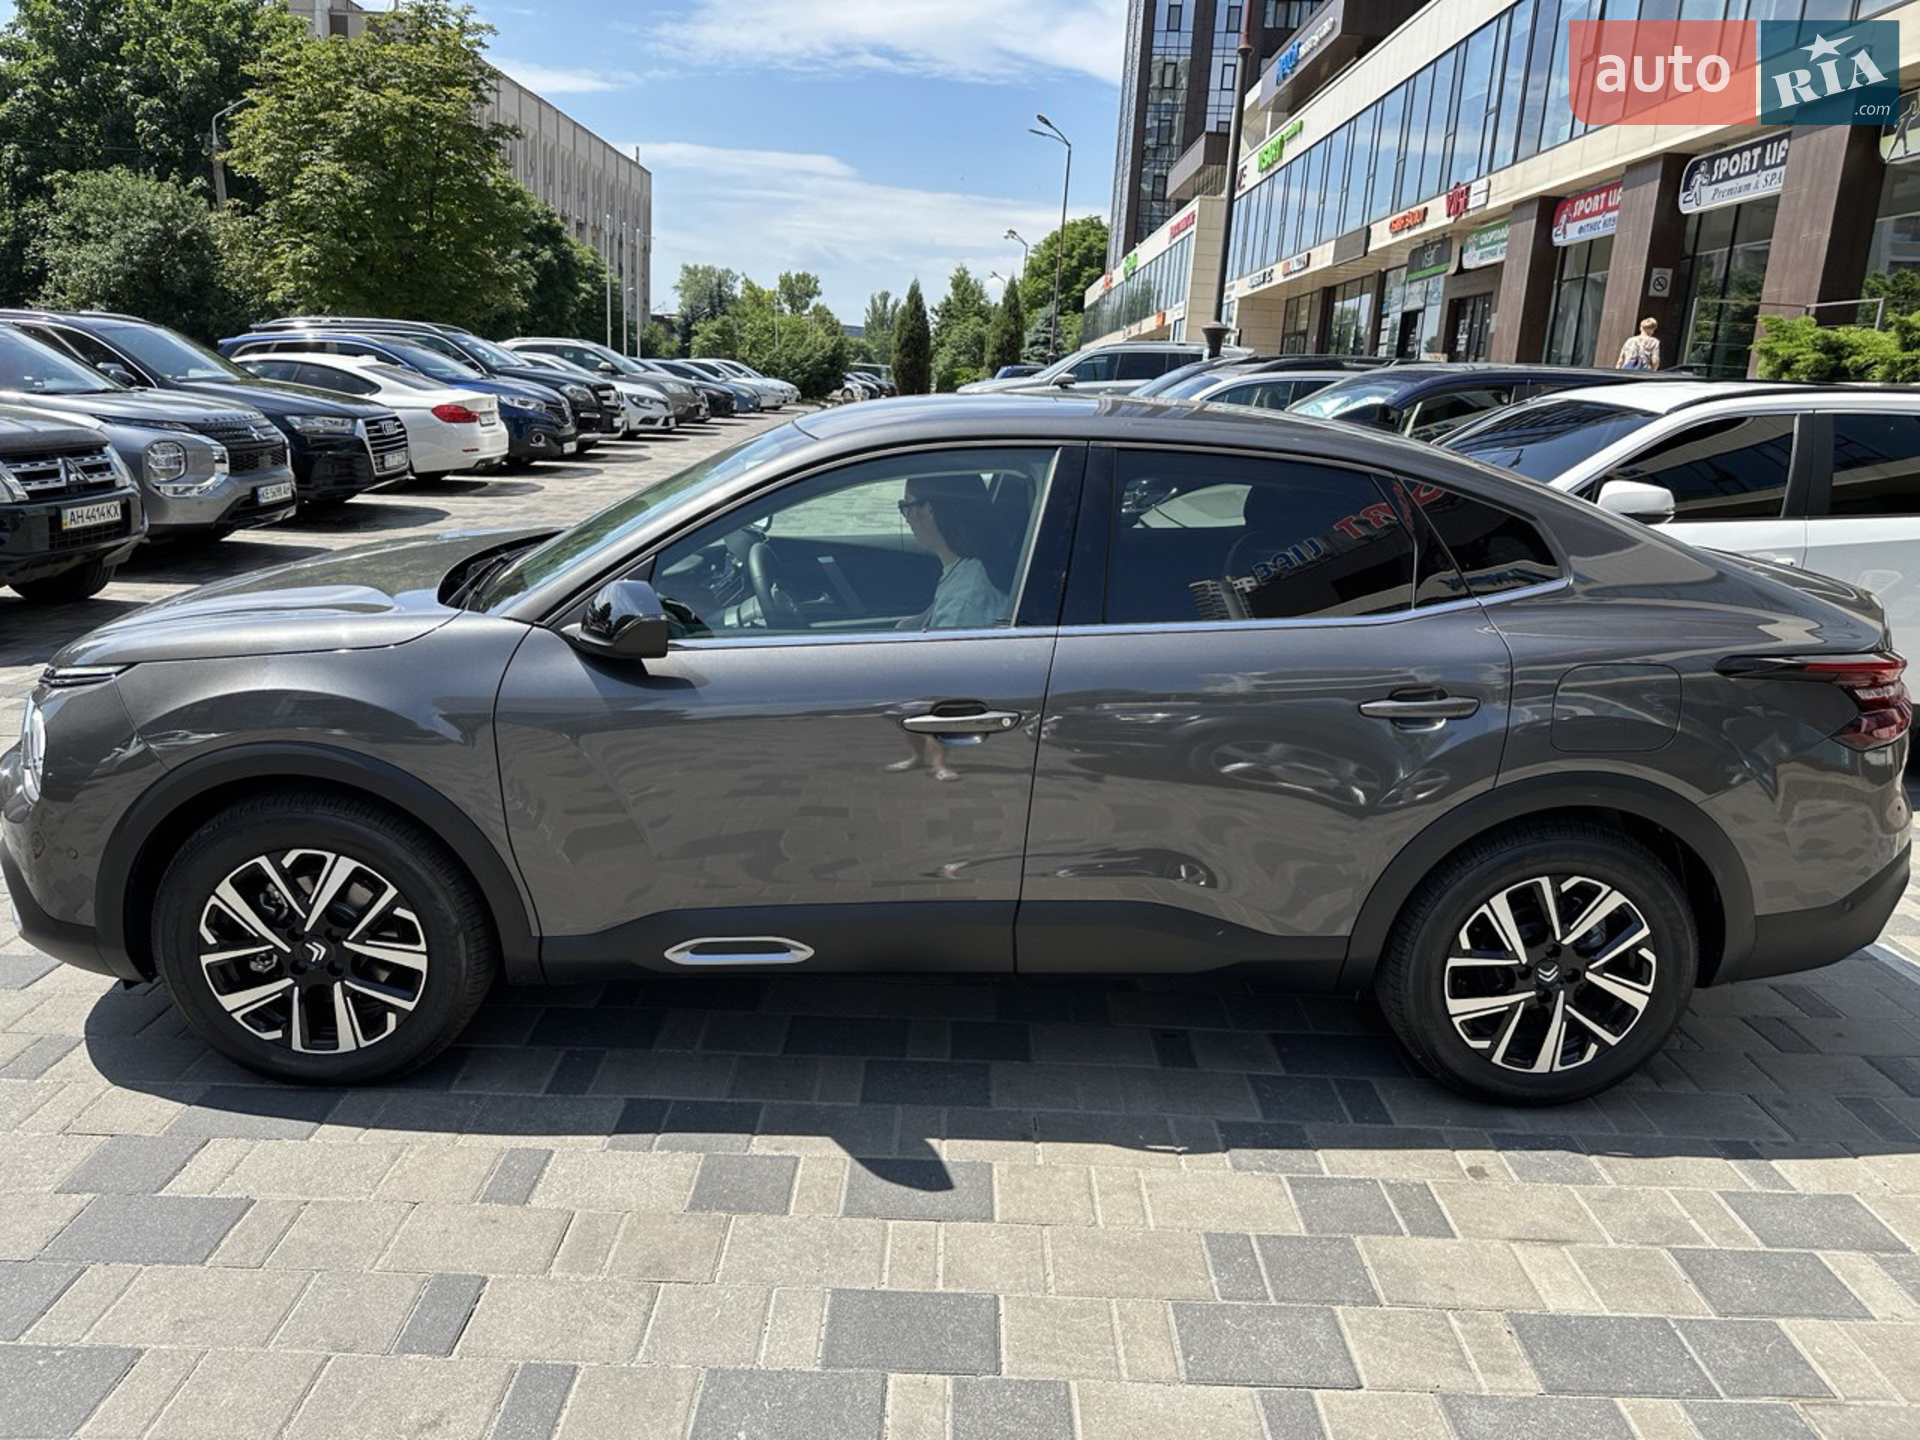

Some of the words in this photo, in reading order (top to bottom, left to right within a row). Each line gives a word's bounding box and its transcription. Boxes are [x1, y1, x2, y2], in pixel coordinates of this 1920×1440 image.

[1711, 146, 1762, 182] SPORT
[1711, 182, 1751, 200] Premium
[1573, 192, 1607, 218] SPORT
